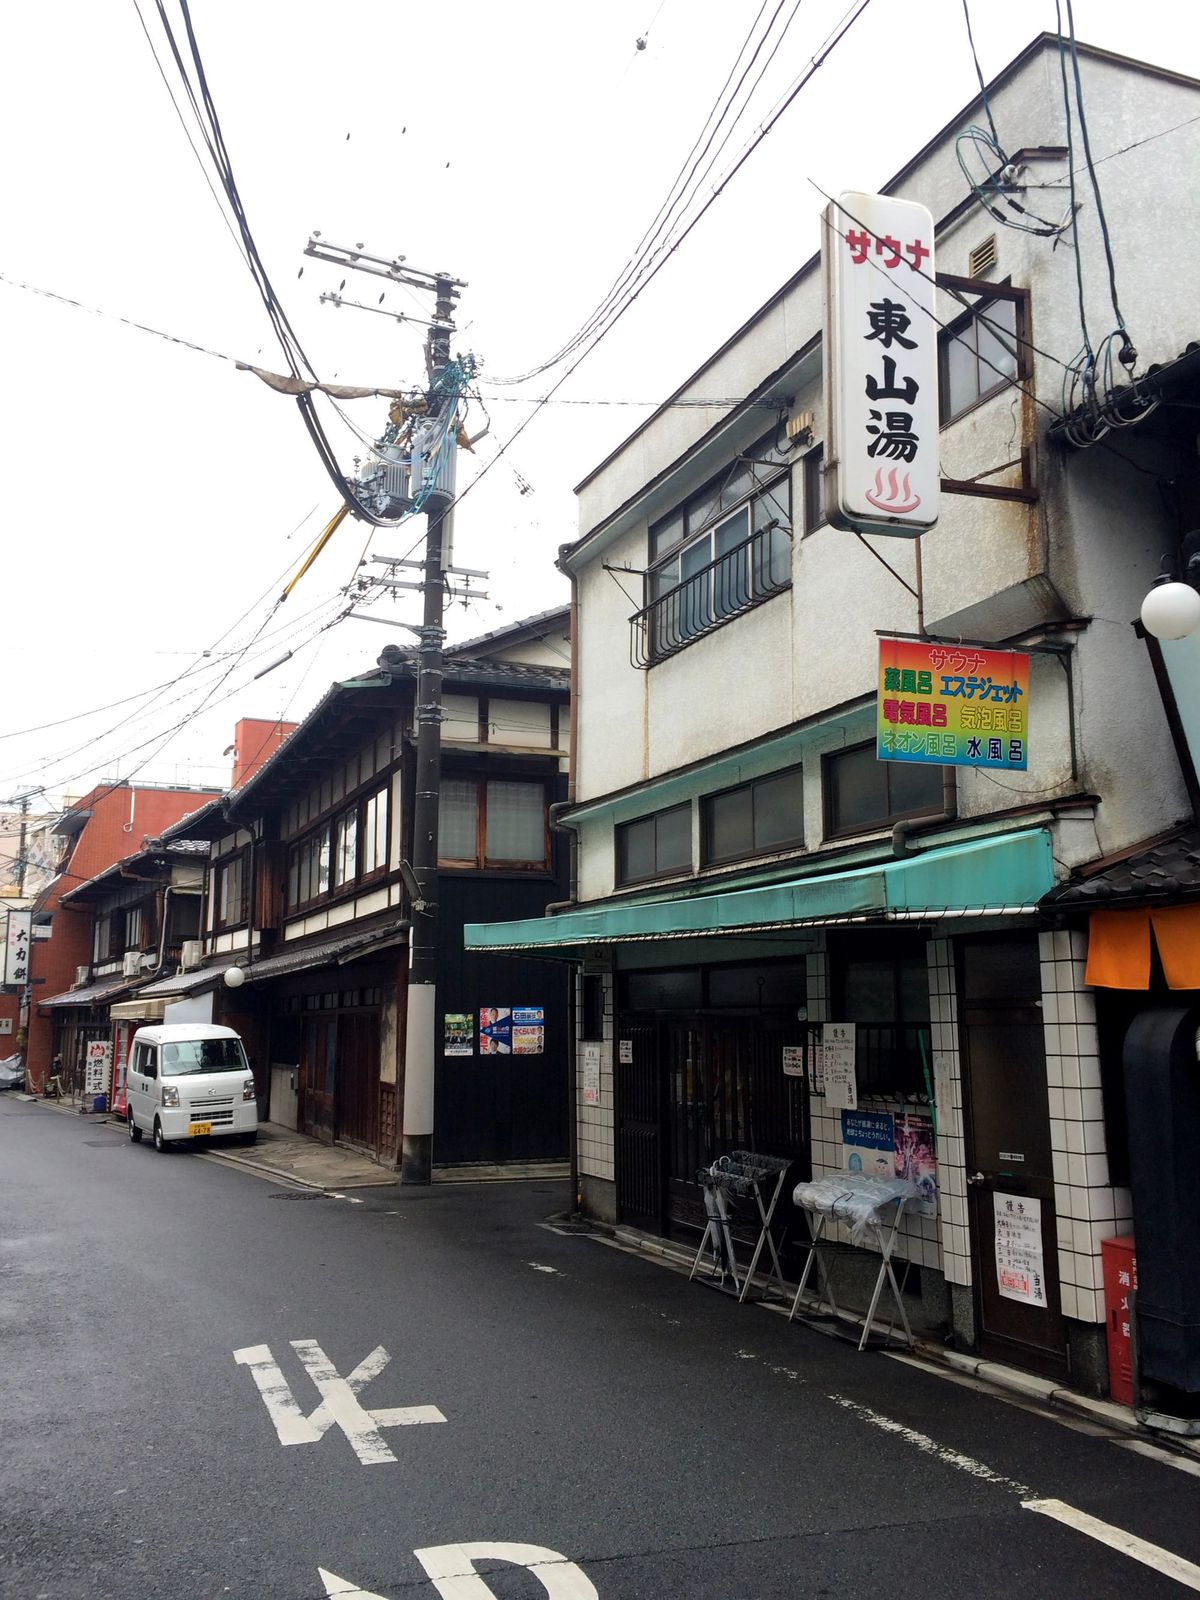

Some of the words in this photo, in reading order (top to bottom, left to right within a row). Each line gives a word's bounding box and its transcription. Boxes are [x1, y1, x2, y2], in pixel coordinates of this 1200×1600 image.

[845, 229, 930, 272] サウナ
[863, 298, 921, 463] 東山湯
[929, 649, 986, 675] サウナ
[884, 667, 933, 695] 薬風呂
[939, 675, 1023, 704] エステジェット
[883, 699, 948, 728] 電気風呂
[960, 705, 1023, 732] 気泡風呂
[883, 730, 957, 757] ネオン風呂
[967, 736, 1024, 761] 水風呂
[13, 929, 28, 980] 大力餅
